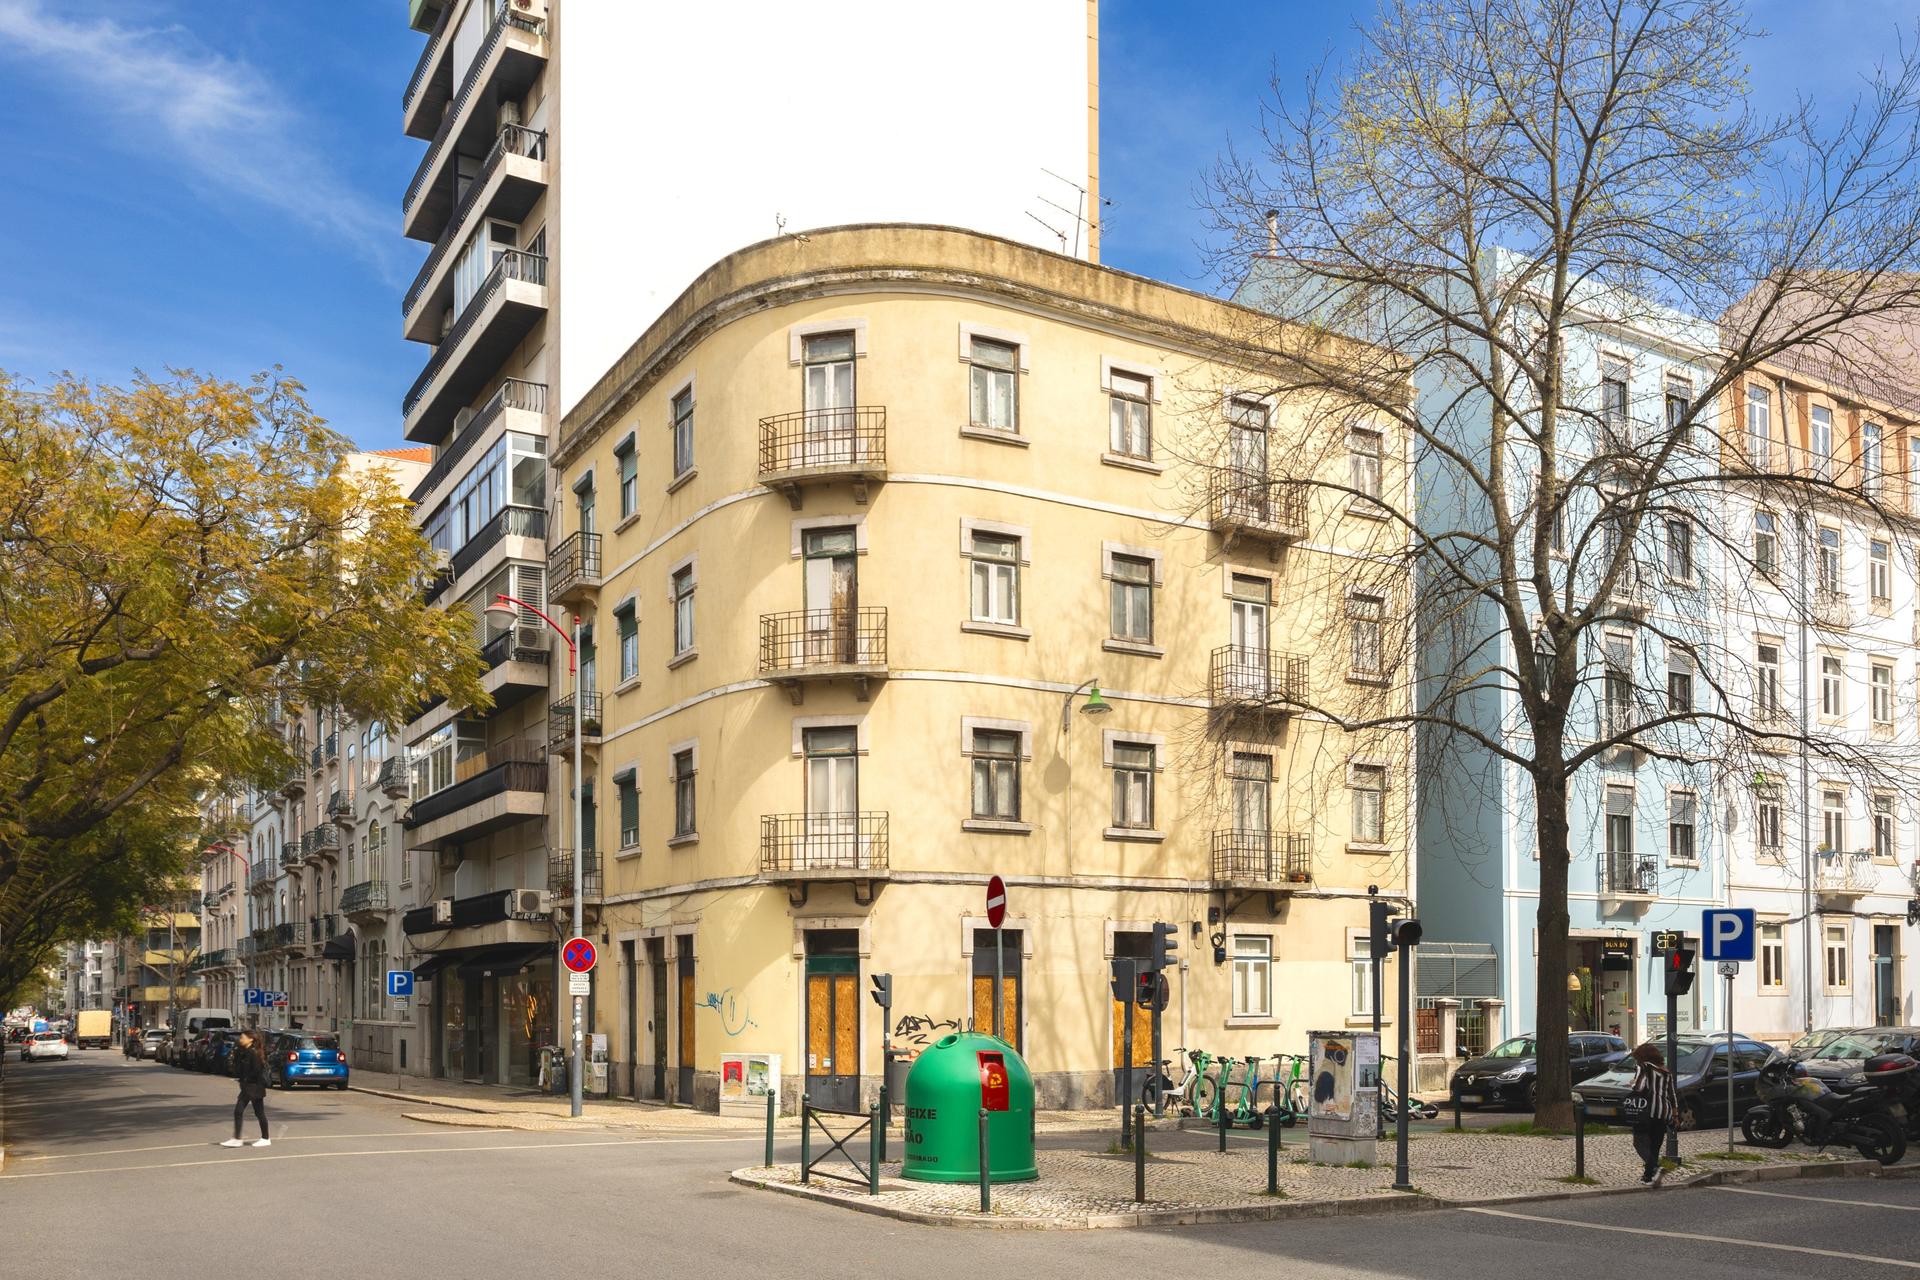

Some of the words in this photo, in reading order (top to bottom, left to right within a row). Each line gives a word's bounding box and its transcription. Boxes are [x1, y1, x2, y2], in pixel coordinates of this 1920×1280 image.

[1713, 913, 1743, 957] P
[394, 974, 407, 993] P
[248, 990, 257, 1003] P
[264, 993, 274, 1006] P
